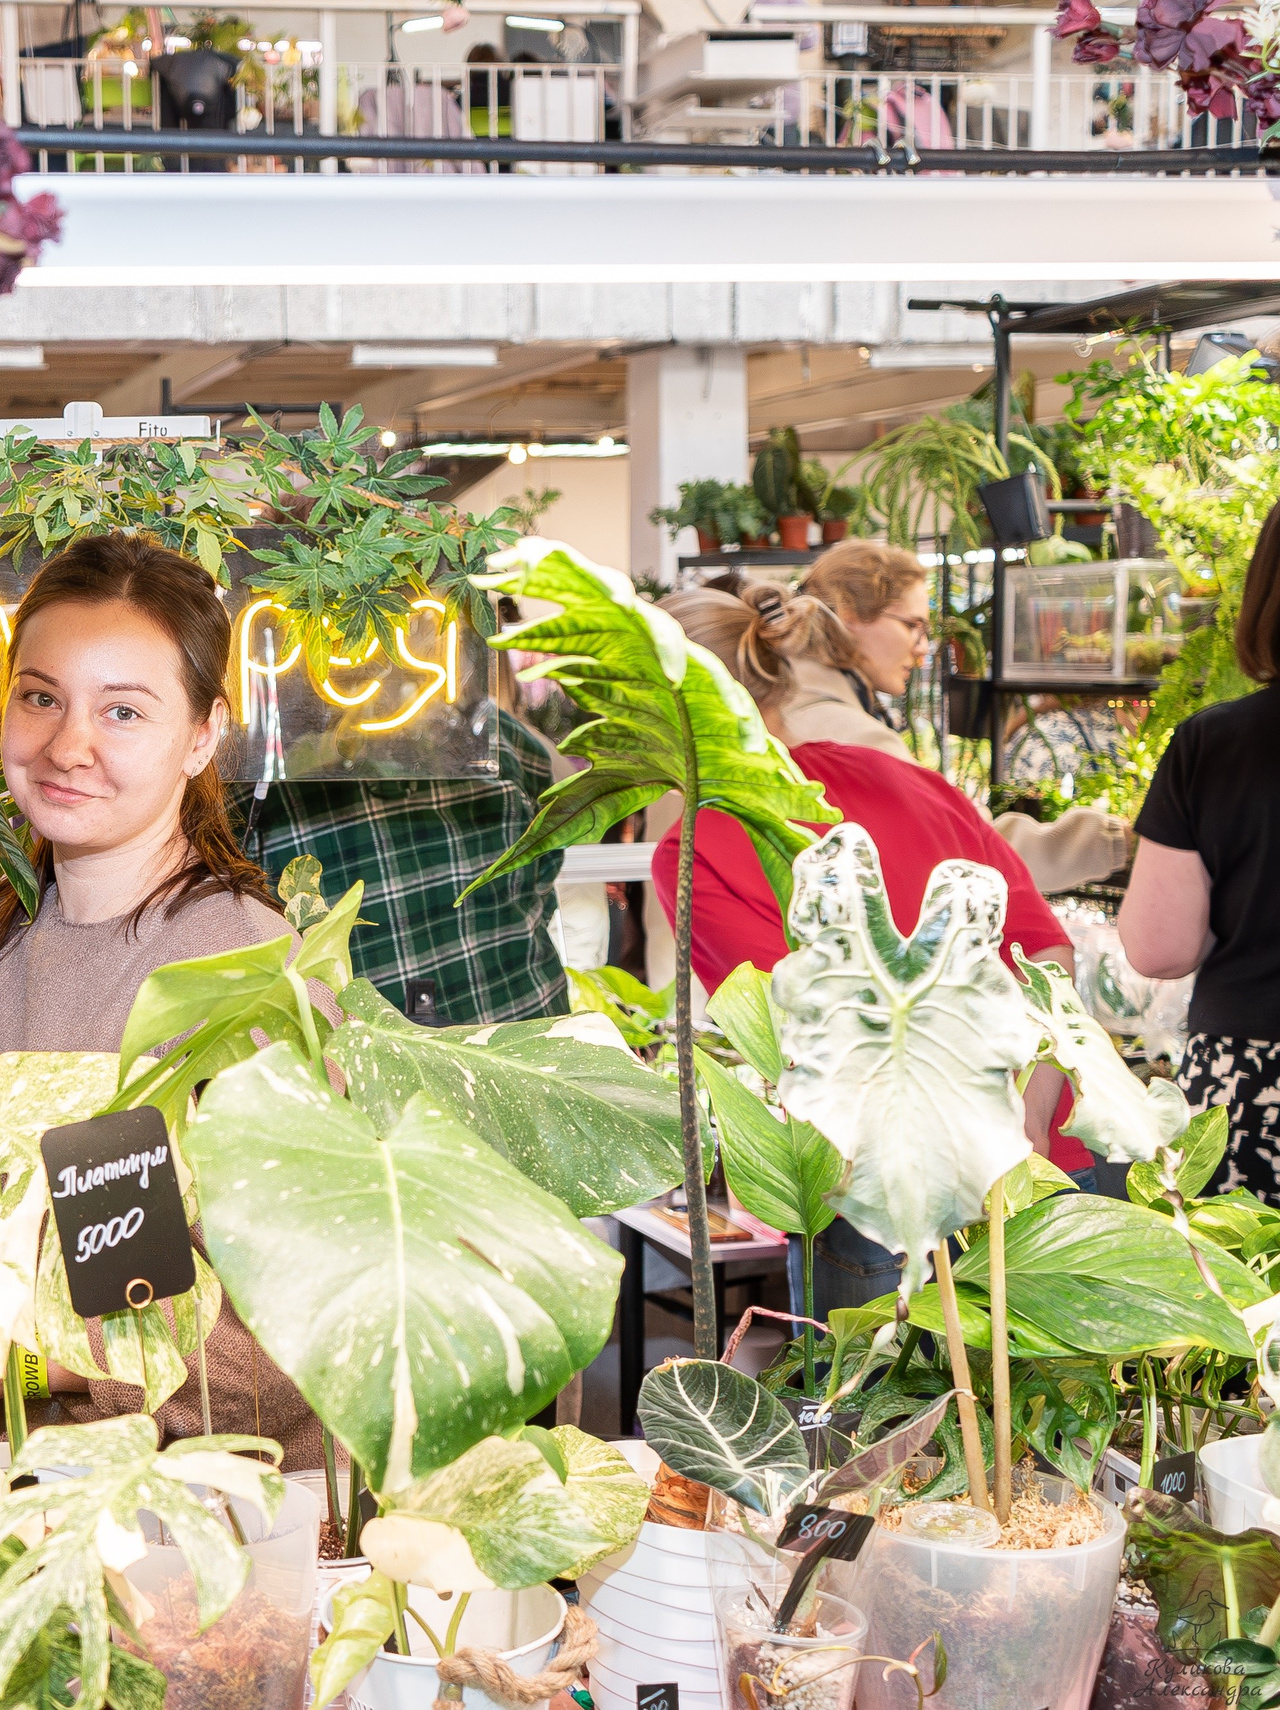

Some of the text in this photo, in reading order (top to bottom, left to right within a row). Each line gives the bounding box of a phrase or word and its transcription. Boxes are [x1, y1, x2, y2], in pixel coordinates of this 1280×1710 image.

[52, 1145, 168, 1198] Платинум
[75, 1207, 145, 1263] 5000
[1160, 1471, 1186, 1494] 1000
[798, 1513, 846, 1539] 800
